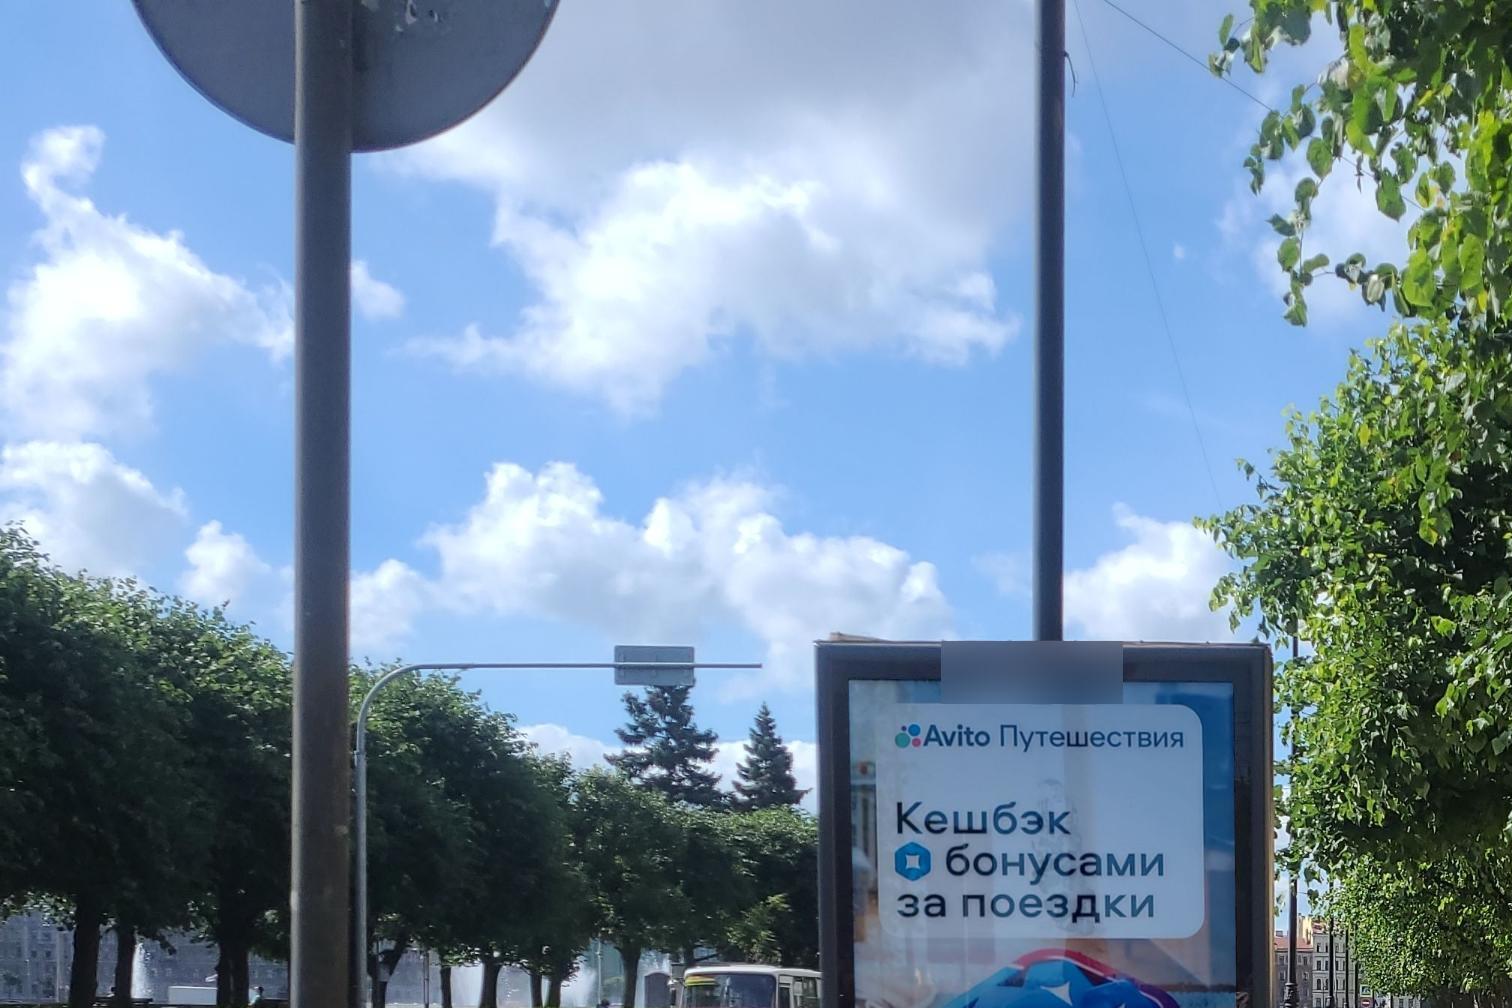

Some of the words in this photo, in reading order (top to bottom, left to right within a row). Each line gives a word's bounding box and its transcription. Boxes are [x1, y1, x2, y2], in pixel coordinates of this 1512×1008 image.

[923, 723, 990, 748] Avito
[1000, 724, 1184, 752] Путешествия
[896, 801, 1071, 835] Кешбэк
[945, 843, 1164, 884] бонусами
[896, 893, 946, 918] за
[962, 893, 1154, 923] поездки
